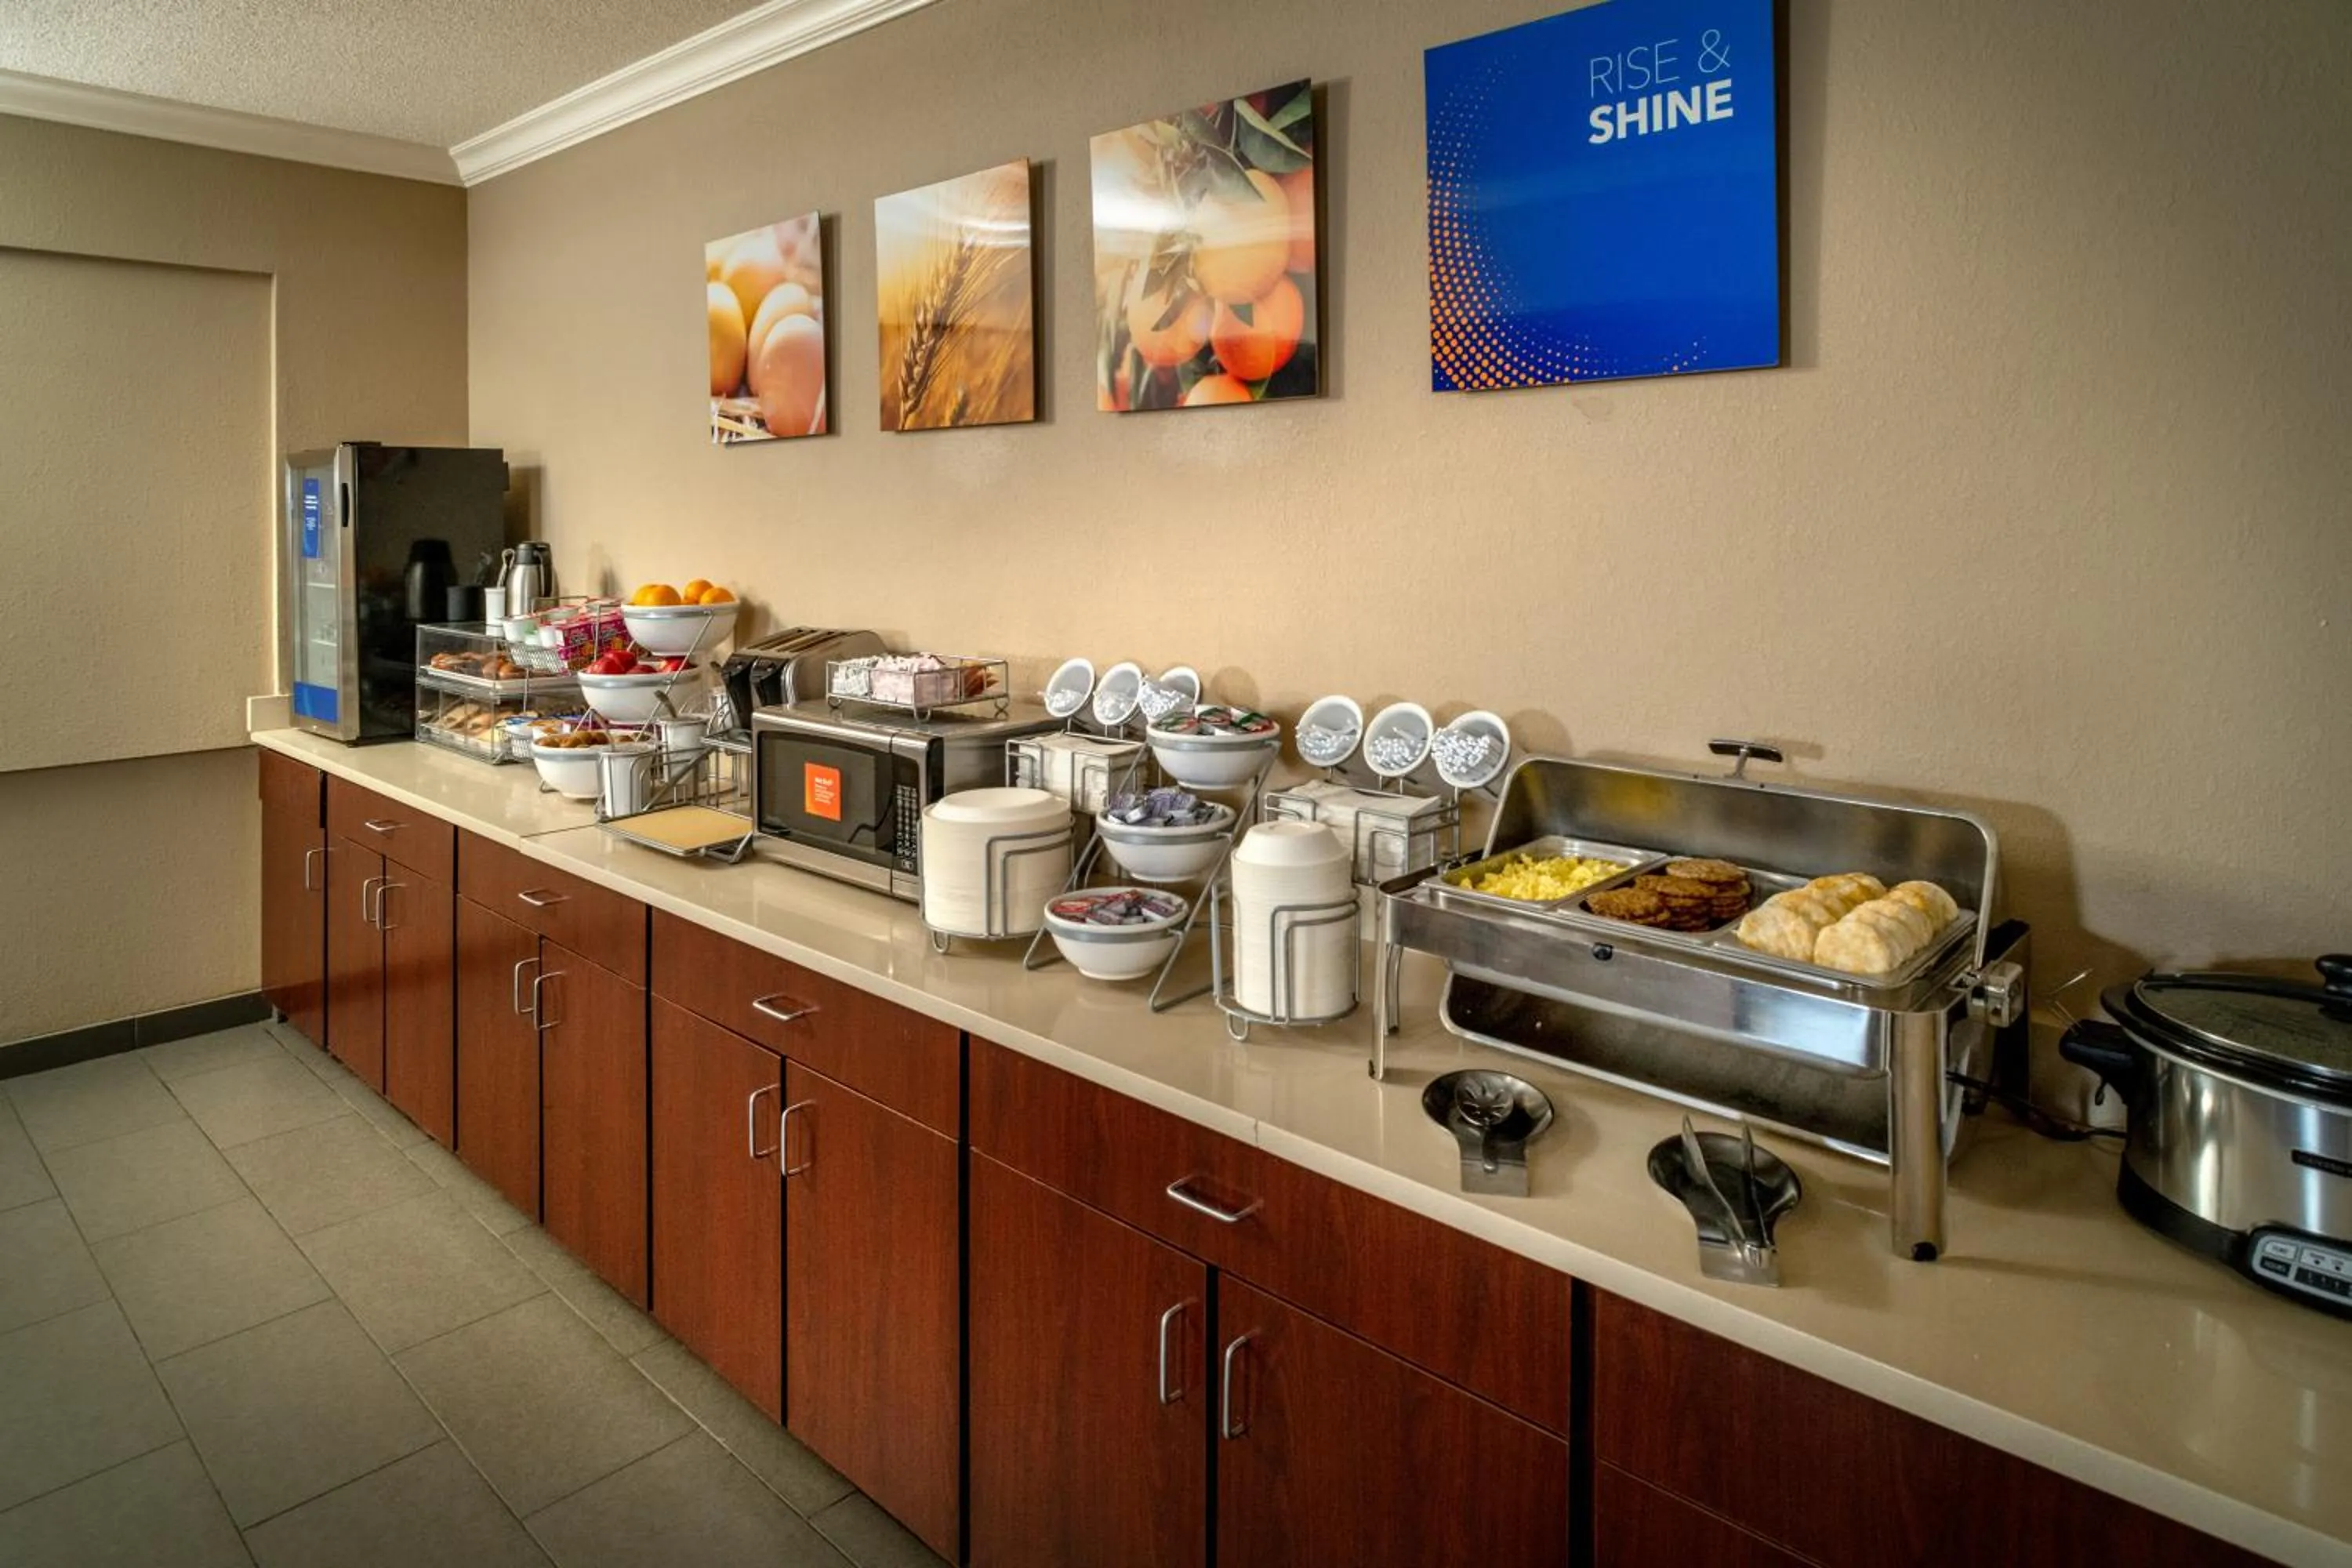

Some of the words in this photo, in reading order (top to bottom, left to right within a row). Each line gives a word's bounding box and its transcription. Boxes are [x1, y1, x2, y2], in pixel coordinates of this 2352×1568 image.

[1590, 38, 1680, 98] RISE
[1697, 29, 1731, 73] &
[1588, 78, 1733, 144] SHINE
